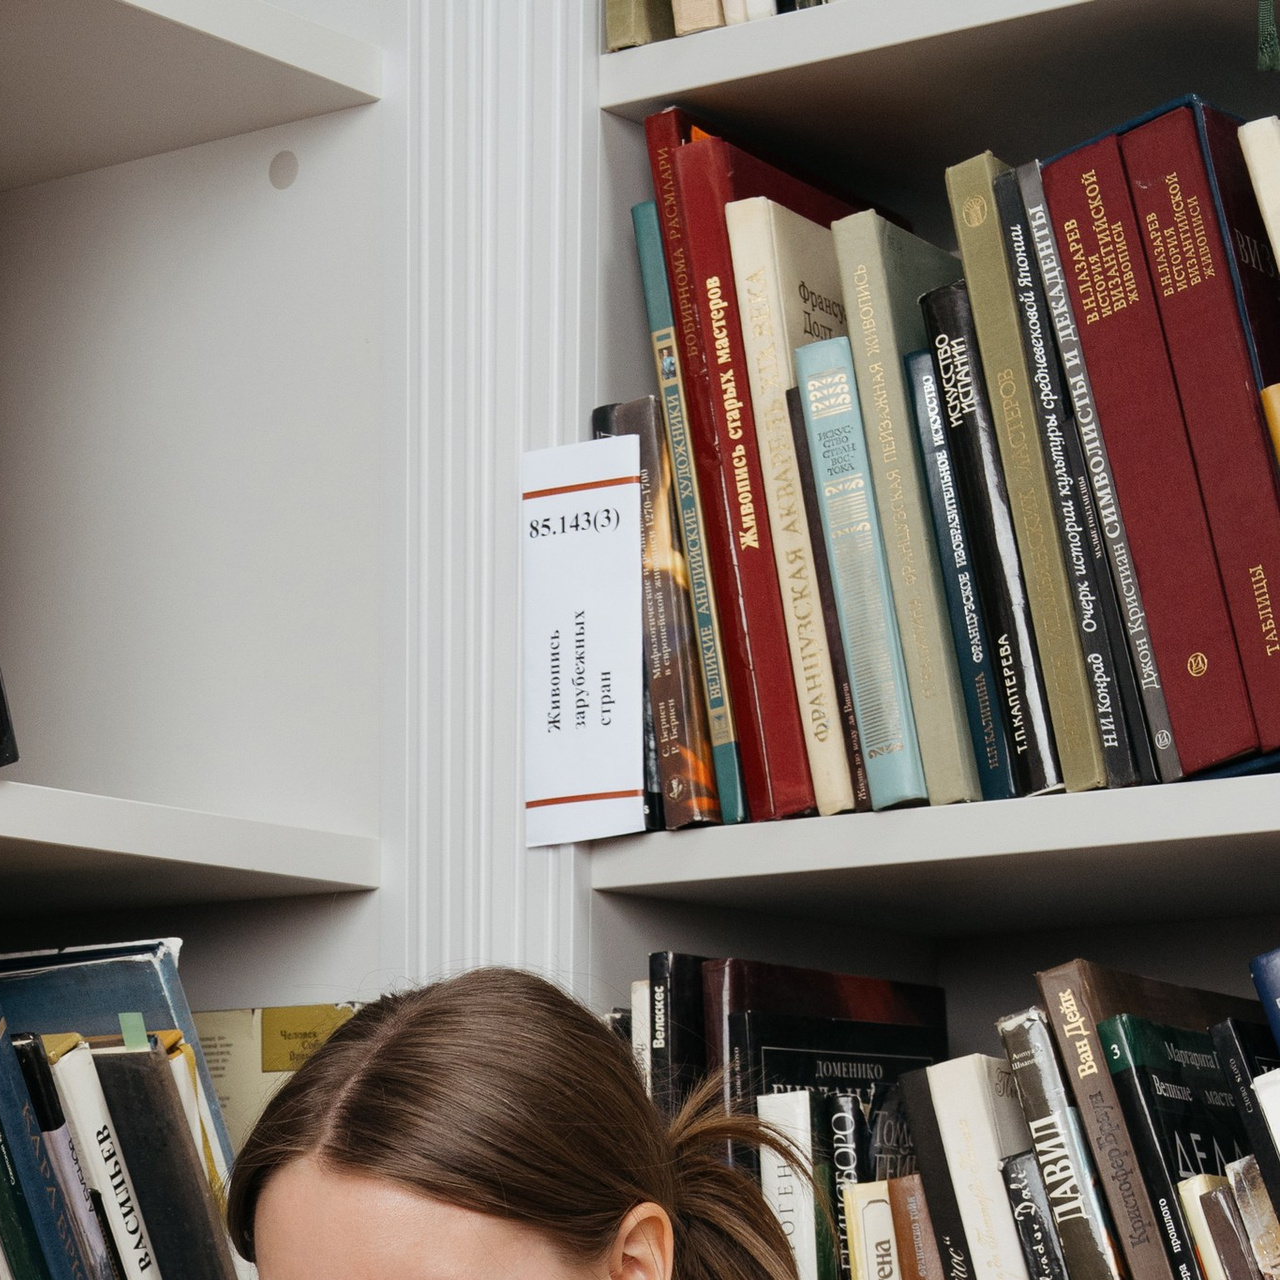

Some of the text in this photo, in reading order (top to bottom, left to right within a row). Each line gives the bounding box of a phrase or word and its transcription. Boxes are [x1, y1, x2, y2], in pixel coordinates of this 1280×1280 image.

[1081, 168, 1128, 313] ВИЗАНТИЙСКОЙ
[1110, 221, 1140, 305] ЖИВОПИСИ
[1162, 226, 1189, 293] ИСТОРИЯ
[1166, 171, 1203, 287] ВИЗАНТИЙСКОЙ
[1187, 194, 1216, 279] ЖИВОПИСИ
[1088, 253, 1113, 319] ИСТОРИЯ
[704, 274, 761, 552] Живопись старых мастеров
[934, 333, 964, 428] ИСКУССТВО
[949, 337, 977, 414] ИСПАНИИ
[1009, 223, 1097, 633] Очерк истории культуры средневековой Японии
[1028, 203, 1161, 690] Джон Кристиан СИМВОЛИСТЫ ДЕКАДЕНТЫ
[528, 507, 622, 541] 85.143(3)
[665, 392, 722, 702] ВЕЛИКИЕ АНГЛИЙСКИЕ ХУДОЖНИКИ
[922, 374, 983, 664] ФРАНЦУЗСКОЕ ИСКУССТВО
[785, 548, 831, 744] ФРАНЦУЗСКАЯ
[1248, 563, 1280, 657] ТАБЛИЦЫ
[547, 629, 563, 734] Живопись
[574, 608, 587, 731] зарубежных
[600, 670, 612, 727] стран
[997, 632, 1028, 755] Т.П.КАПТЕРЕВА
[652, 985, 665, 1050] Веласкес
[1058, 988, 1098, 1080] Ван Дейк
[815, 1060, 884, 1080] ДОМЕНИКО
[96, 1123, 152, 1275] ВАСИЛЬЕВ
[1028, 1110, 1092, 1224] ДАВИД
[1158, 1197, 1181, 1254] прошлого
